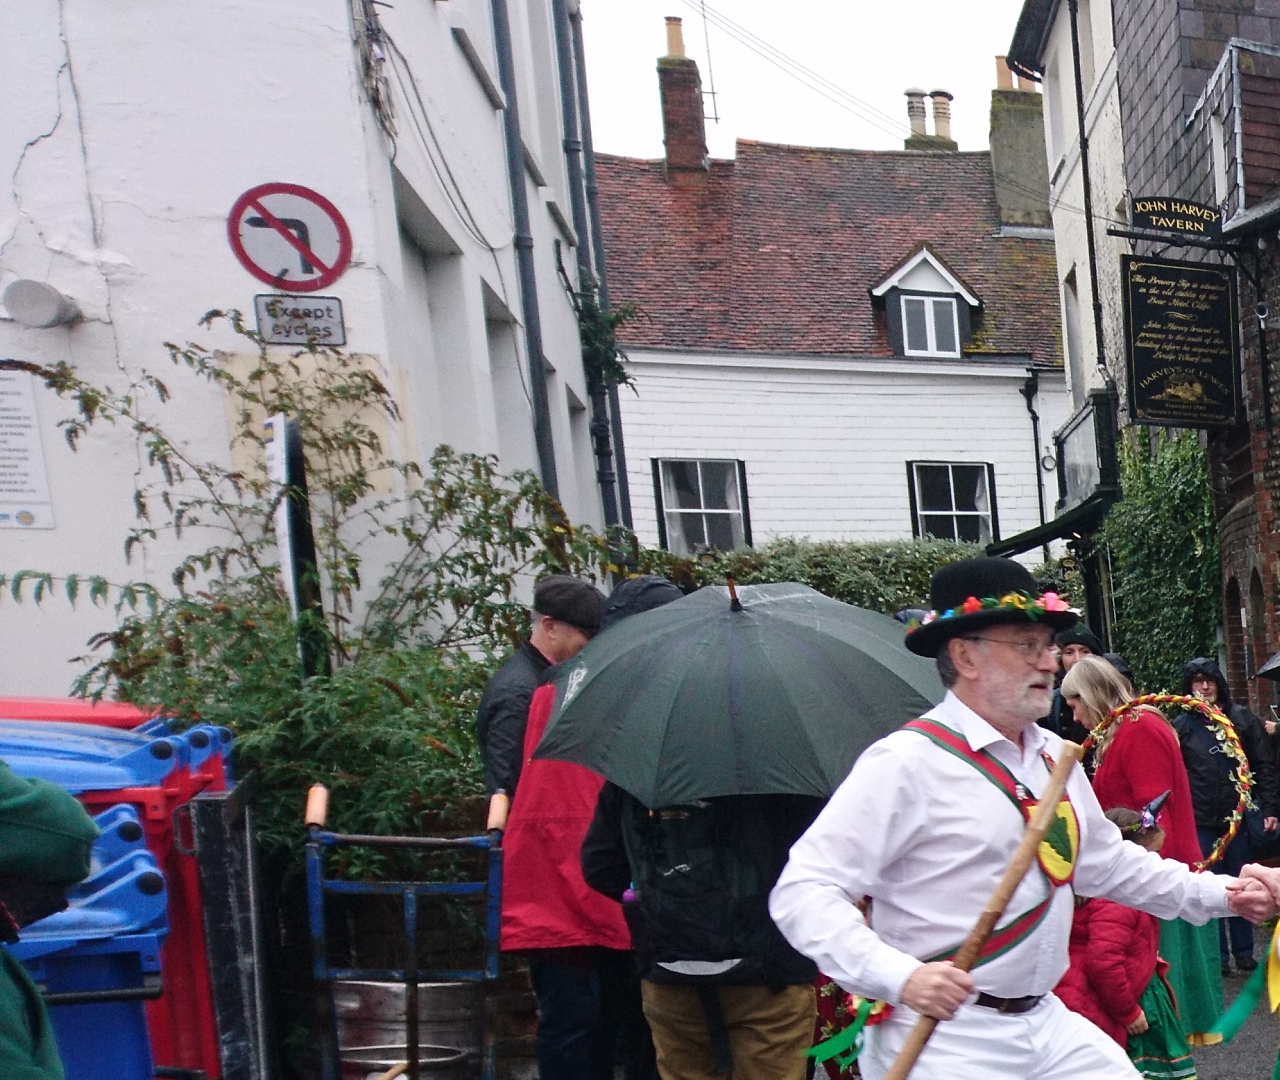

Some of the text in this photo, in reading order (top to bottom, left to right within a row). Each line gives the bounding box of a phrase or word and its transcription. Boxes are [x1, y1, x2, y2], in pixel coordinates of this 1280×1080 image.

[1135, 200, 1220, 222] JOHN HARVEY
[1149, 216, 1204, 232] TAVERN
[266, 300, 334, 319] xept
[272, 322, 333, 338] cycles
[1139, 366, 1182, 389] HARVEYS
[1199, 370, 1230, 395] LEWES
